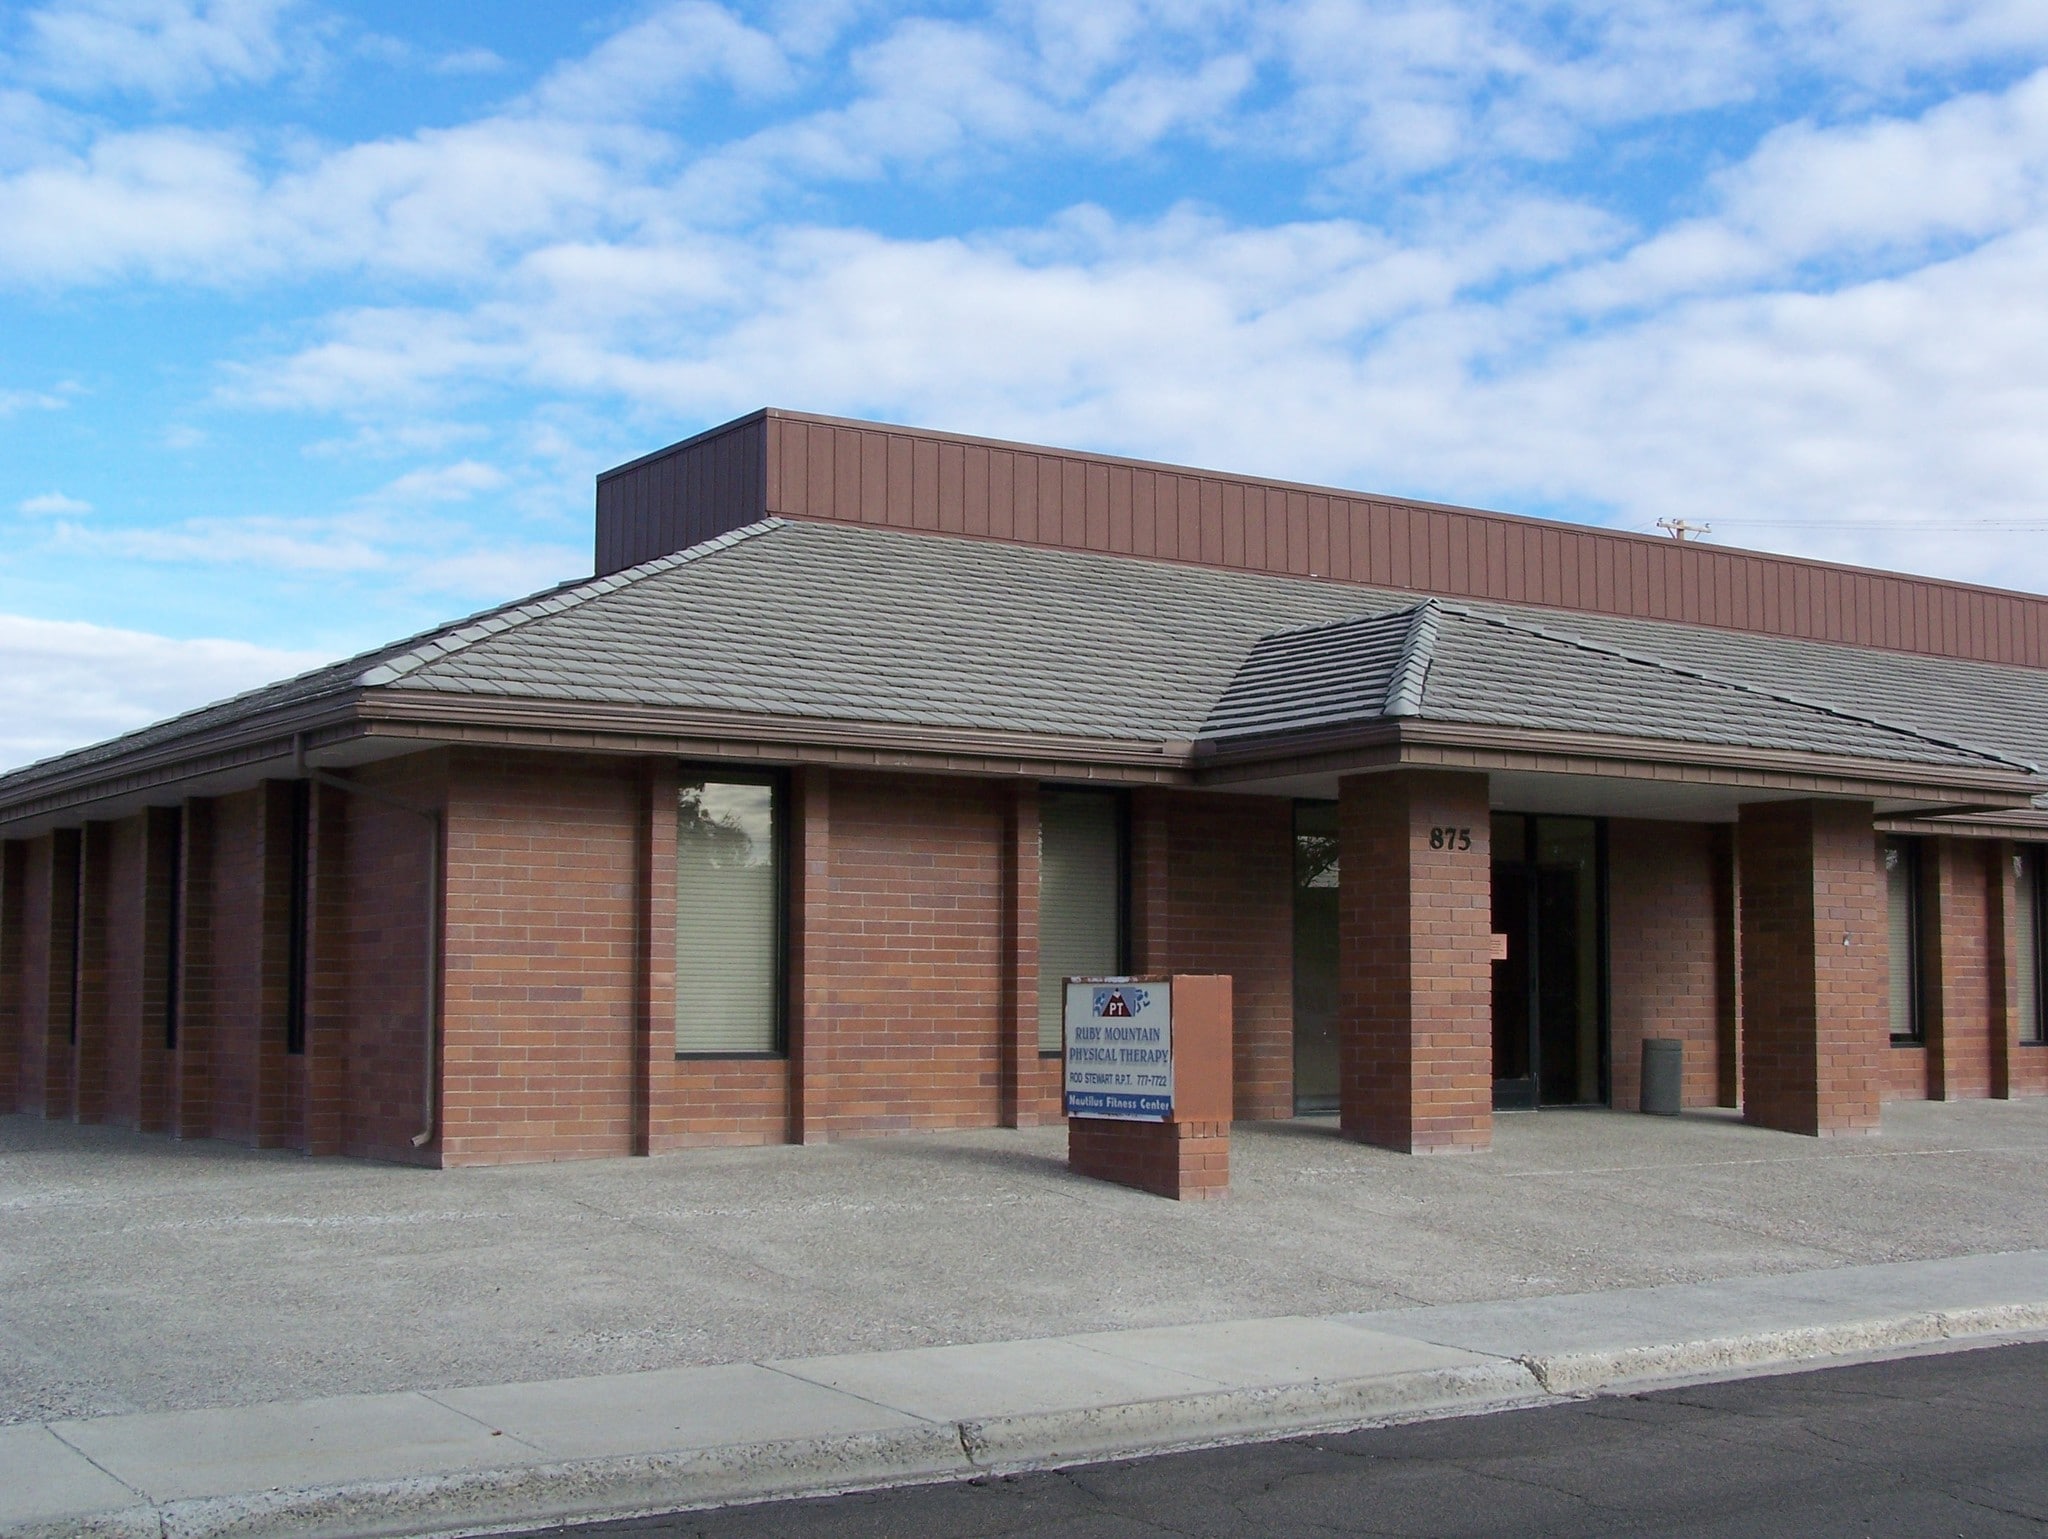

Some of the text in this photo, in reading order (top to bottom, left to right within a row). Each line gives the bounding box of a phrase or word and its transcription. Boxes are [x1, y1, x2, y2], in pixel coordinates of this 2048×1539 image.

[1429, 827, 1472, 851] 875
[1109, 1002, 1124, 1016] PT
[1075, 1026, 1160, 1042] RUBY MOUNTAIN
[1069, 1047, 1168, 1063] PHYSICAL THERAPY
[1084, 1072, 1113, 1085] STEWART
[1137, 1074, 1167, 1087] 777-7722
[1068, 1094, 1169, 1111] Nautilus Fitness Center
